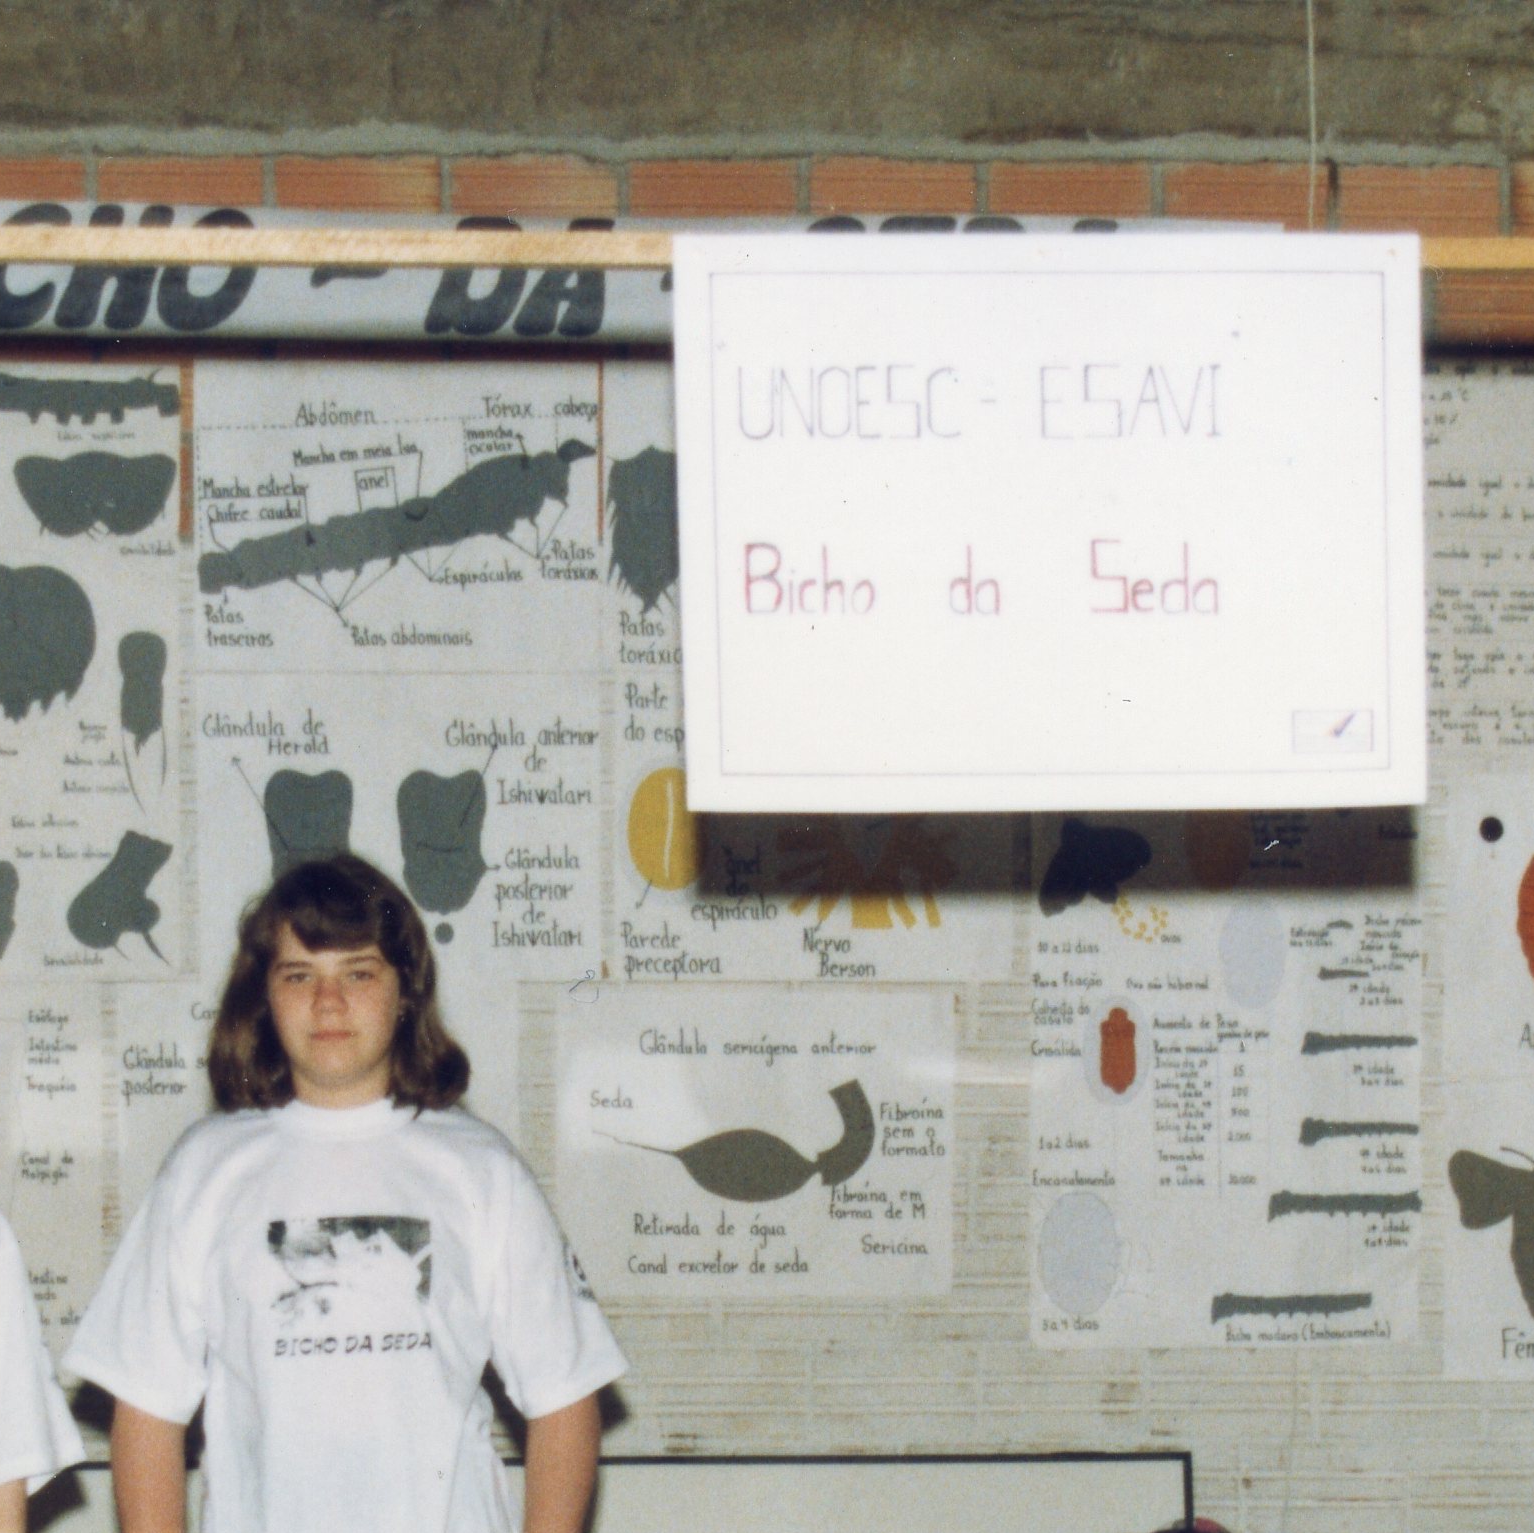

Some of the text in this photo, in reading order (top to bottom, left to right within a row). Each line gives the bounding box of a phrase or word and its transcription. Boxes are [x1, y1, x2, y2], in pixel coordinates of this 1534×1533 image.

[424, 216, 615, 337] DA
[481, 393, 533, 419] Tórax
[738, 364, 962, 439] UNOESC
[1040, 363, 1222, 439] ESAVI
[294, 401, 377, 428] Abdômen
[292, 444, 336, 468] Mancha
[202, 477, 251, 499] Mancha
[208, 499, 302, 524] Chifre caudal
[551, 540, 595, 561] Patas
[745, 537, 1219, 616] Bicho da Seda
[204, 605, 244, 624] Patas
[619, 610, 665, 637] Patas
[207, 629, 274, 648] traseiras
[351, 623, 473, 646] Patas abdominais
[625, 682, 669, 710] Parte
[202, 706, 325, 740] Glândula de
[444, 716, 527, 749] Glândula
[624, 723, 646, 743] do
[266, 734, 329, 758] Herold
[523, 743, 548, 772] de
[494, 779, 593, 806] Ishiwatari
[503, 843, 581, 872] Glândula
[493, 872, 574, 911] posterior
[521, 901, 547, 926] de
[690, 897, 778, 933] espiráculo
[490, 919, 584, 949] Ishiwatari
[620, 921, 681, 949] Parede
[801, 924, 852, 956] Nervo
[625, 952, 723, 982] preceptora
[817, 956, 877, 979] Berson
[123, 1042, 186, 1071] Glândula
[638, 1028, 878, 1068] Glândula sericígena anterior
[590, 1090, 634, 1111] Seda
[879, 1096, 945, 1122] Fibroína
[883, 1125, 915, 1142] sem
[880, 1139, 947, 1159] formato
[899, 1188, 923, 1203] em
[827, 1202, 927, 1221] forma de M
[633, 1213, 787, 1250] Retirada de água
[861, 1233, 929, 1257] Sericina
[627, 1247, 810, 1276] Canal excretor de seda
[1073, 1316, 1100, 1332] dias
[275, 1332, 432, 1357] BICHO DA SEDA
